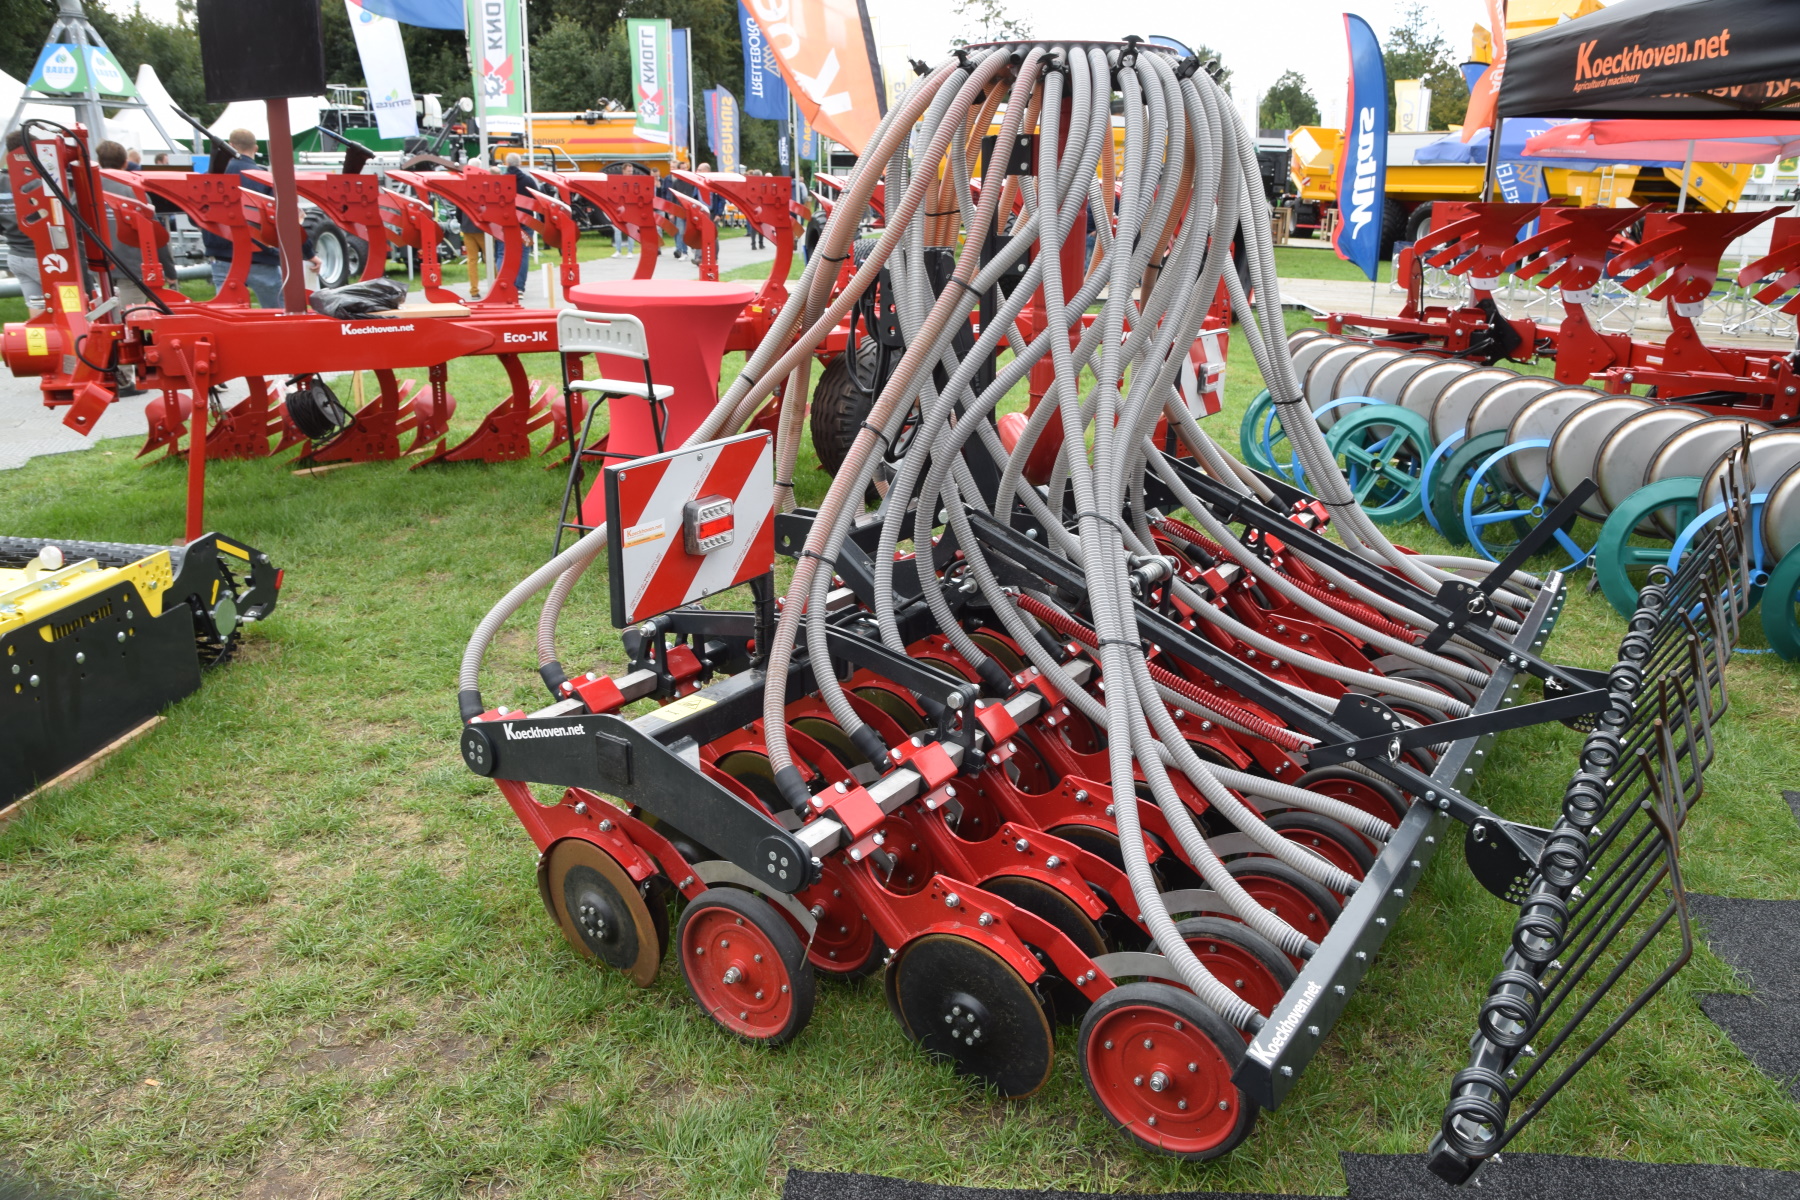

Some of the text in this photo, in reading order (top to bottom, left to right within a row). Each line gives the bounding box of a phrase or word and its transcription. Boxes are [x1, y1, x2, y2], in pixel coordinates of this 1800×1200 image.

[1575, 28, 1731, 81] Koeckhoven.net
[45, 65, 75, 74] BAUER
[1573, 73, 1641, 93] Agricultural machinery
[341, 323, 415, 335] Koeckhoven.net
[503, 331, 548, 343] Eco-JK
[503, 722, 586, 741] Koeckhoven.net
[1249, 980, 1322, 1066] Koeckhoven.net
